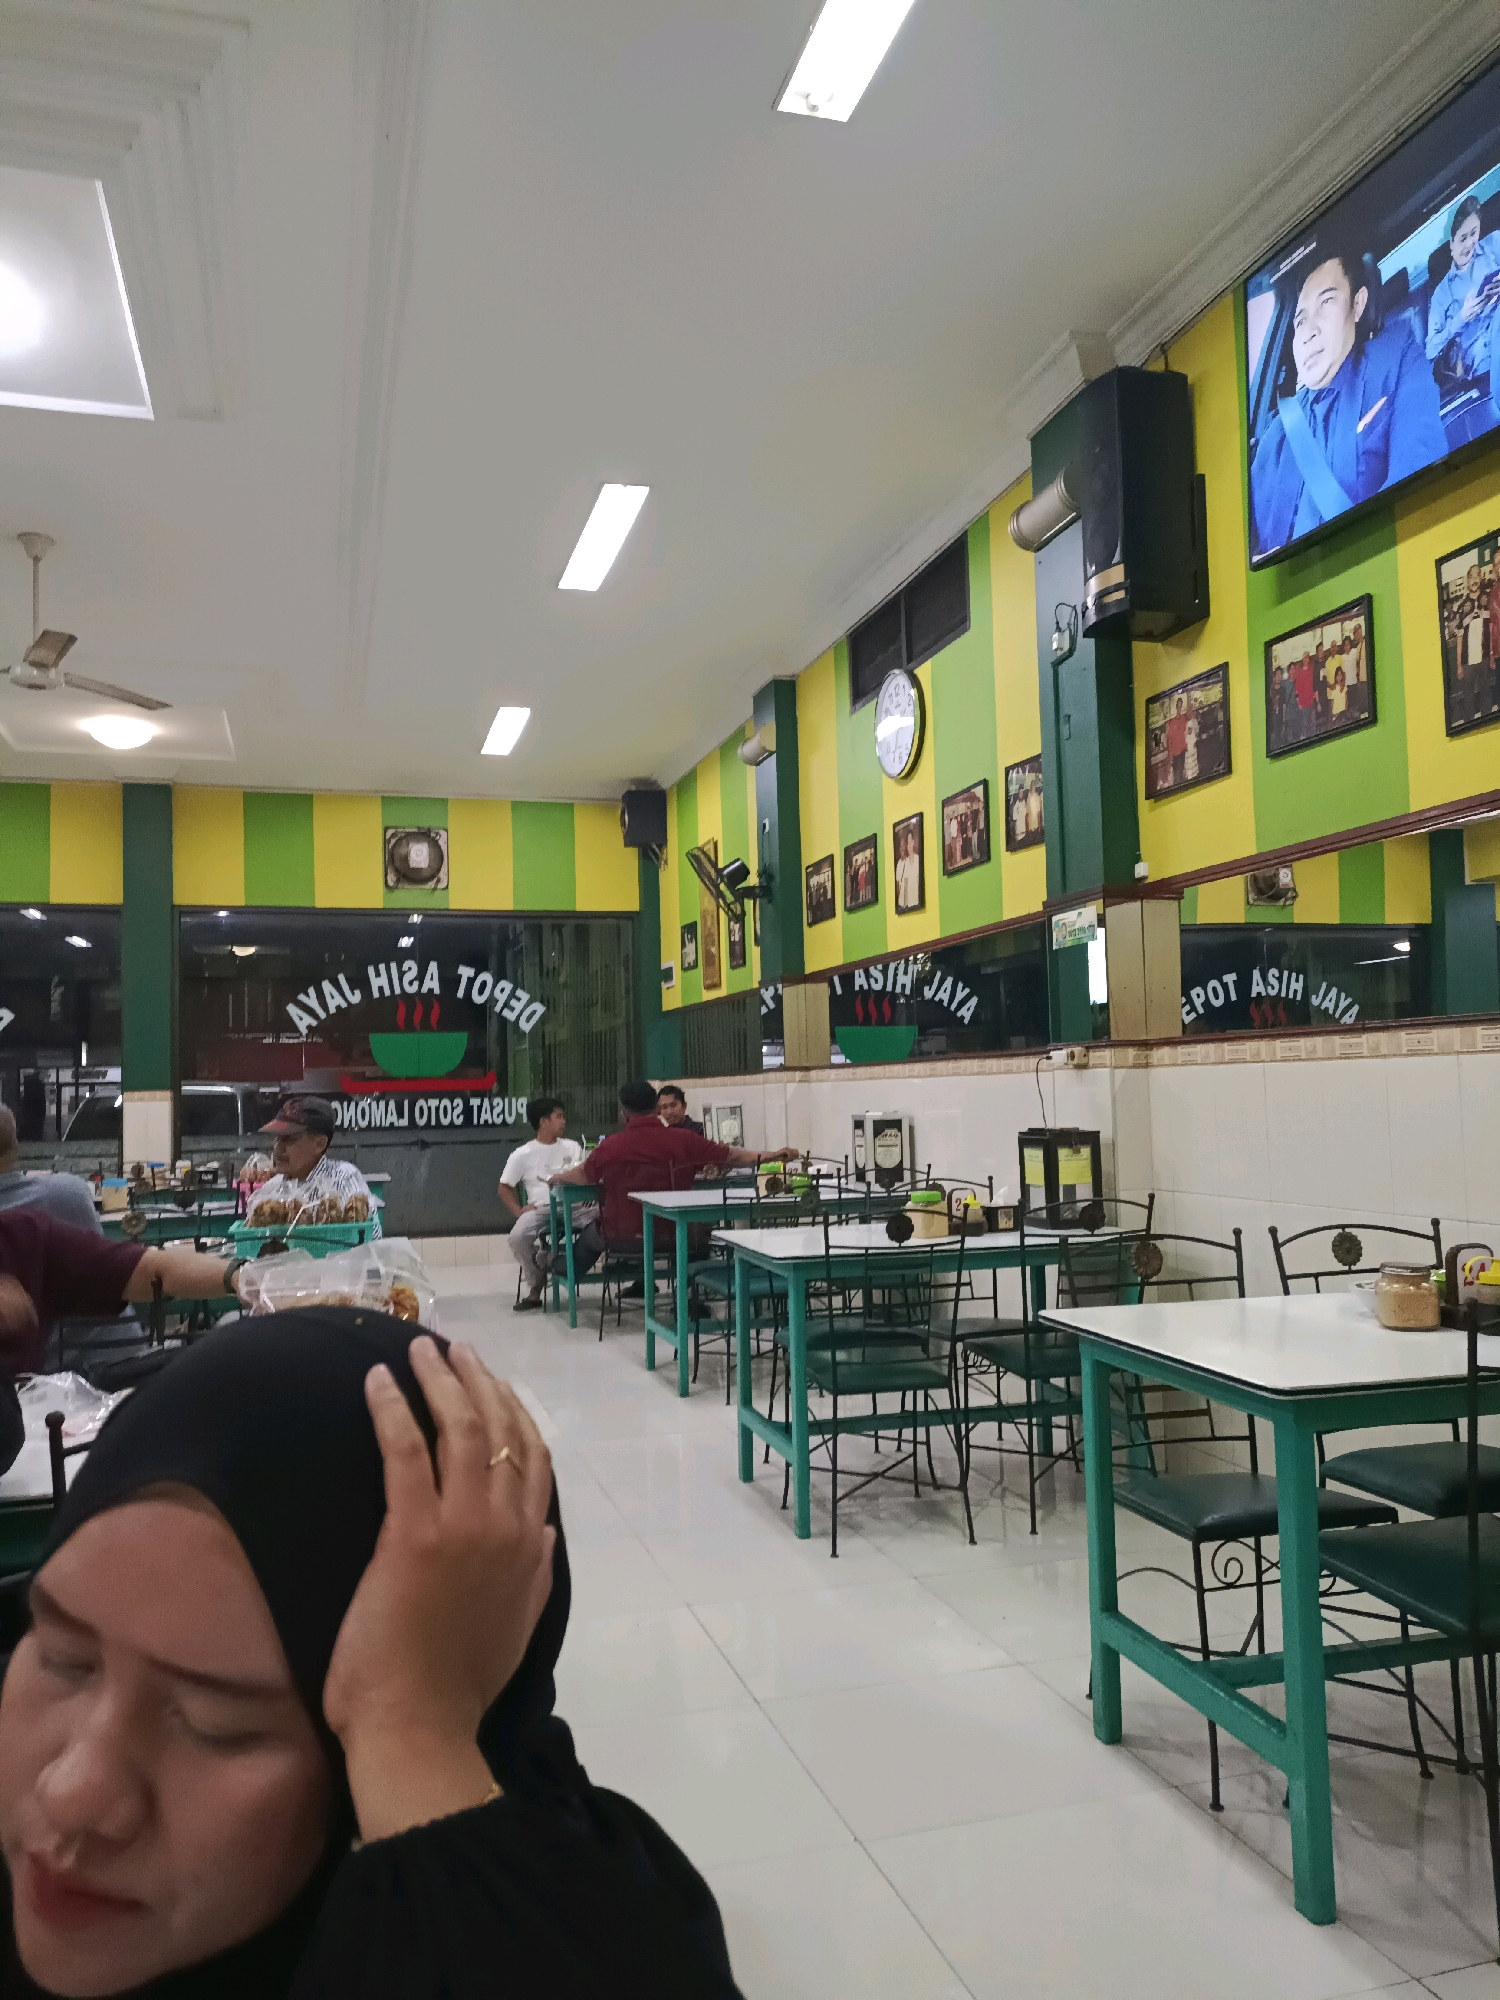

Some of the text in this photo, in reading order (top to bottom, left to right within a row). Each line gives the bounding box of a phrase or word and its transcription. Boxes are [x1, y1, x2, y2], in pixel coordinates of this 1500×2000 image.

[854, 958, 917, 996] ASIH
[923, 970, 979, 1026] JAYA
[1250, 967, 1304, 1001] ASIH
[1311, 981, 1360, 1025] JAYA
